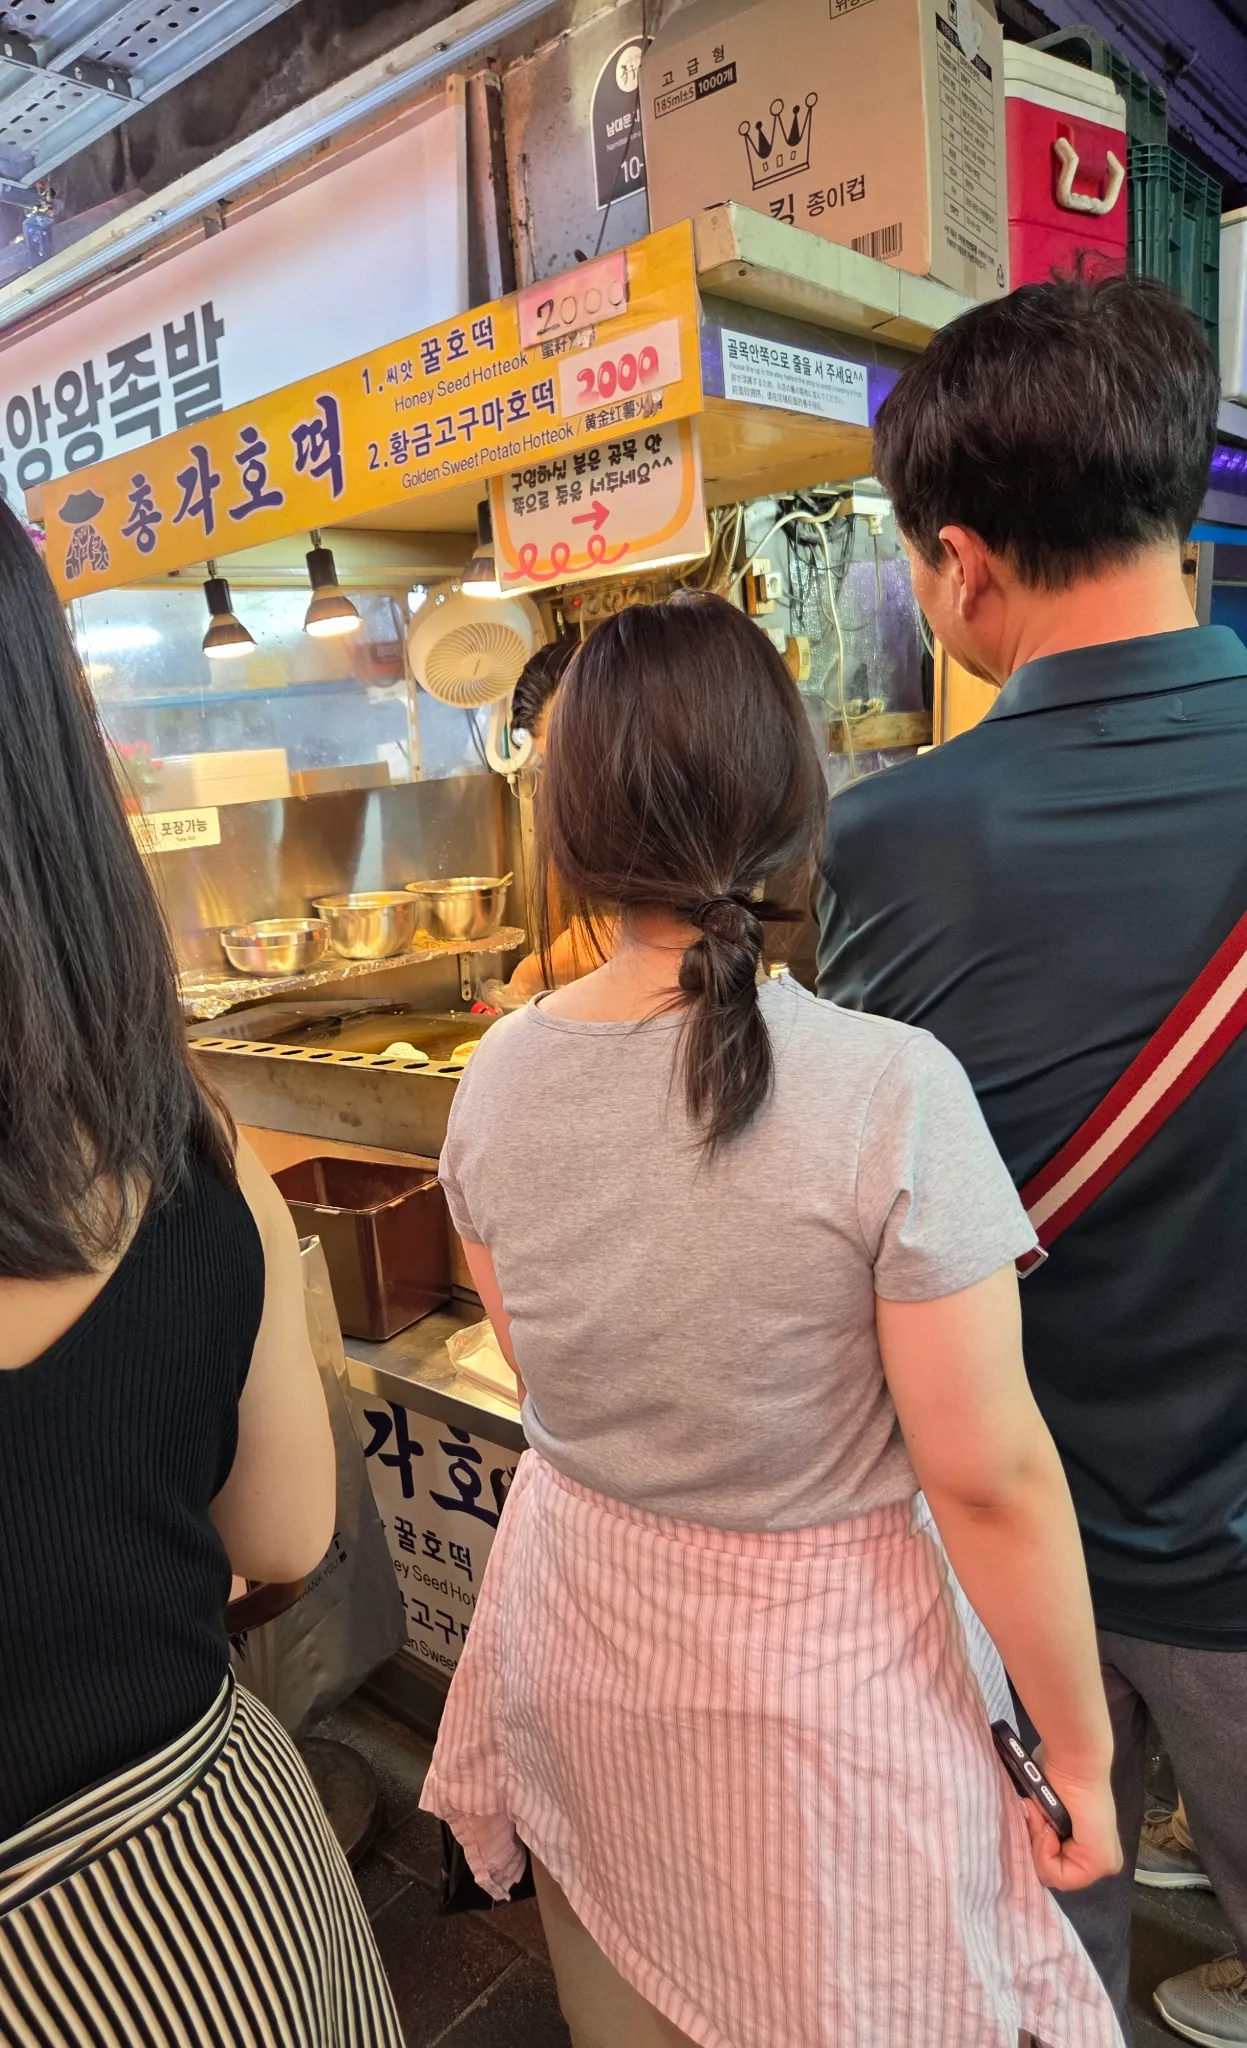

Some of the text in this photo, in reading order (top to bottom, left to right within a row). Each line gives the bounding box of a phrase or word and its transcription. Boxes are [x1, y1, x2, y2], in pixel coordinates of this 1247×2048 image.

[698, 67, 734, 94] 1000개
[807, 175, 866, 217] 종이컵
[537, 280, 625, 336] 2000
[420, 316, 494, 375] 꿀호떡
[577, 345, 660, 404] 2000
[728, 338, 790, 370] 골목안쪽으로
[792, 353, 811, 377] 줄을
[815, 360, 823, 380] 서
[0, 301, 225, 490] 앙왕족발
[395, 388, 435, 412] Honey
[437, 371, 470, 397] Seed
[473, 351, 528, 384] Hotteok
[121, 395, 344, 553] 총각호떡
[402, 467, 441, 488] Golden
[441, 454, 479, 476] Sweet
[480, 441, 521, 466] Potato
[523, 423, 574, 452] Hotteok
[511, 433, 662, 493] 구입하실 분은 골목 안
[555, 480, 583, 506] 줄을
[161, 818, 208, 836] 포장가능
[394, 1515, 473, 1582] 꿀호떡
[412, 1564, 448, 1595] Seed
